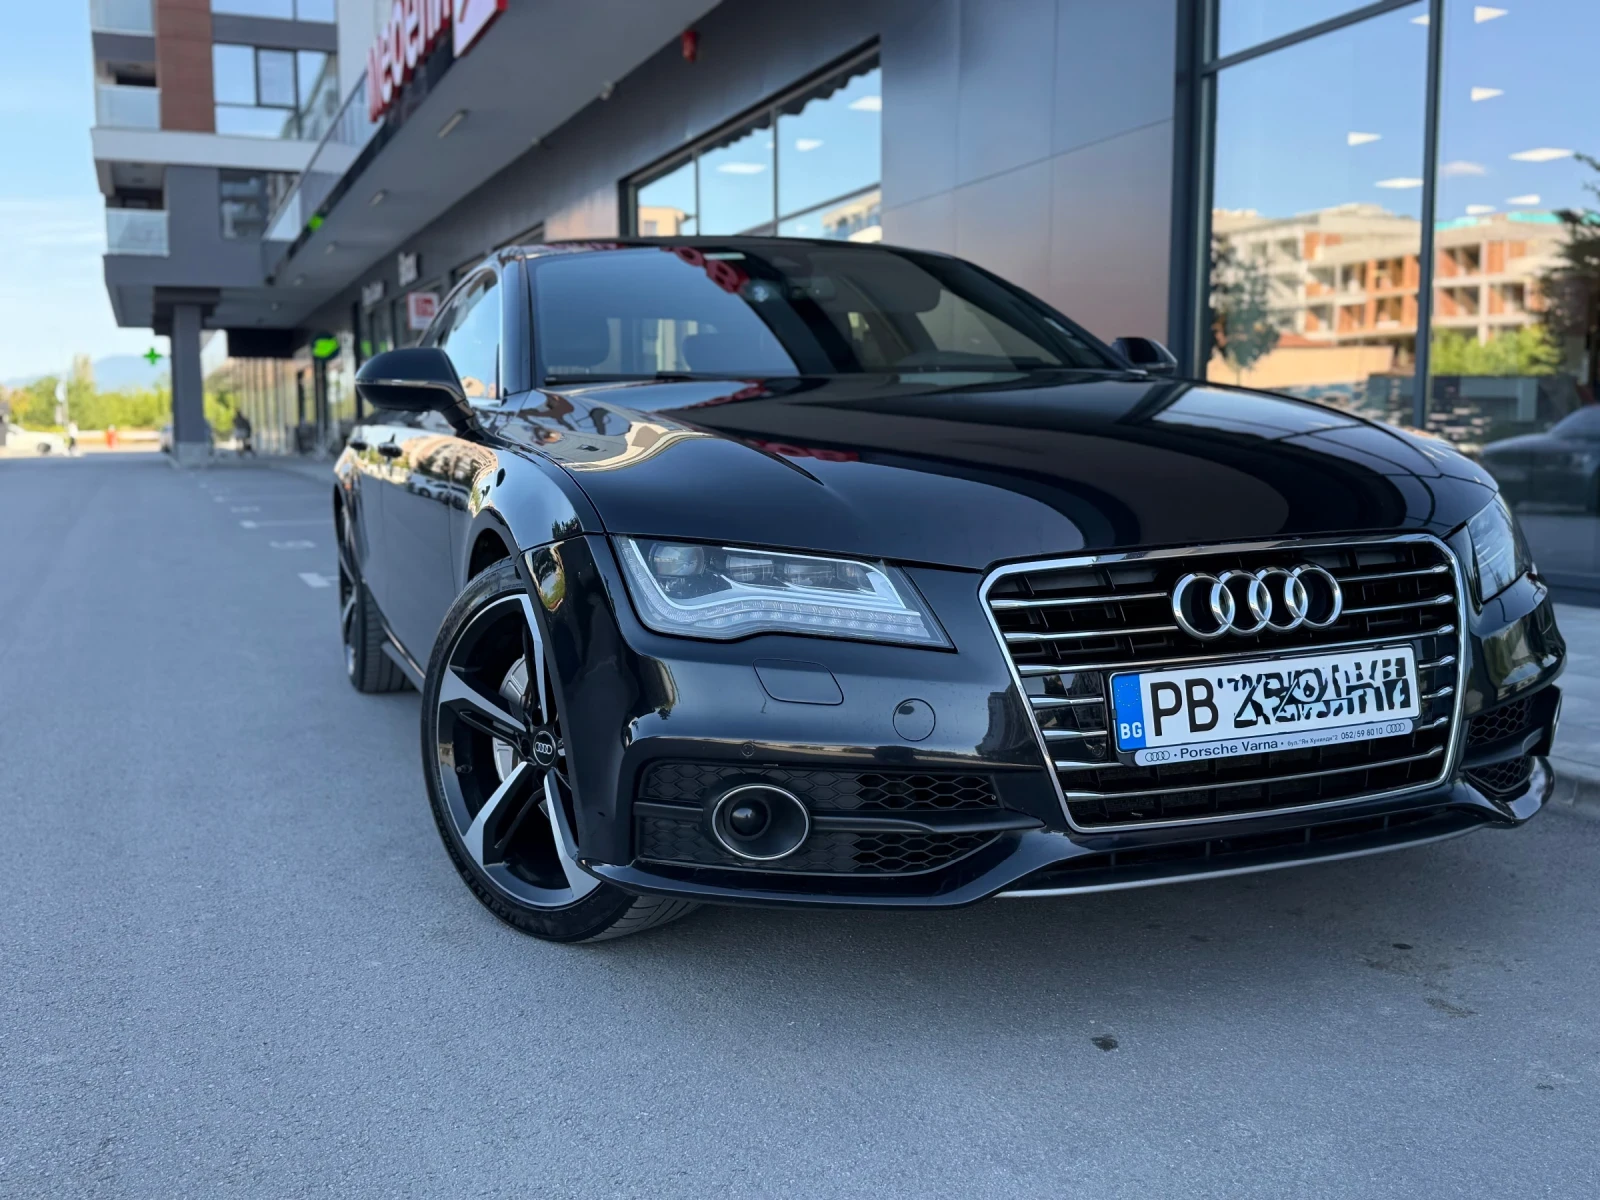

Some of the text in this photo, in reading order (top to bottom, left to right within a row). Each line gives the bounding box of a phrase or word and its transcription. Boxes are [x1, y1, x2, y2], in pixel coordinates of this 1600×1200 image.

[1150, 678, 1219, 736] PB
[1120, 722, 1143, 739] BG
[1179, 738, 1278, 759] Porsche Varna
